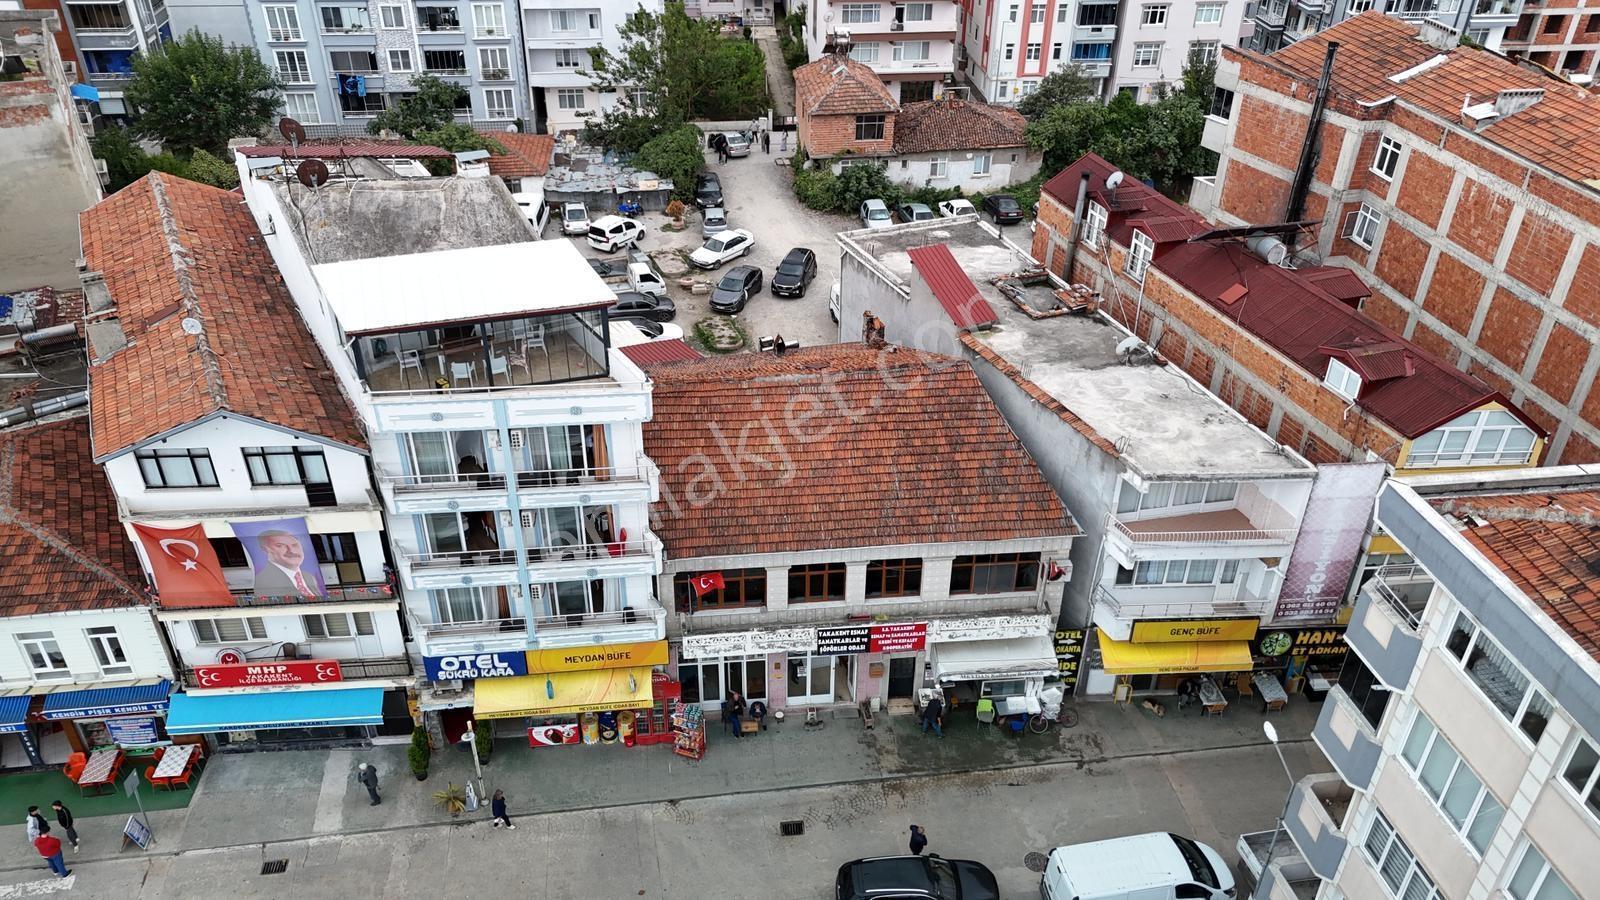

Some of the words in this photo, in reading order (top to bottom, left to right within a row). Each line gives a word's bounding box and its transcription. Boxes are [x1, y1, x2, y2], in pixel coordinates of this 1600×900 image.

[1056, 631, 1083, 639] OTEL
[1170, 628, 1194, 637] GENÇ
[1056, 645, 1081, 653] OKANTA
[1291, 647, 1307, 655] ET
[1308, 646, 1348, 655] LOKAN
[440, 653, 508, 671] OTEL
[565, 653, 604, 664] MEYDAN
[1059, 660, 1077, 670] İDE
[247, 666, 287, 675] MHP
[481, 667, 515, 678] KARA
[114, 705, 148, 713] KENDİN
